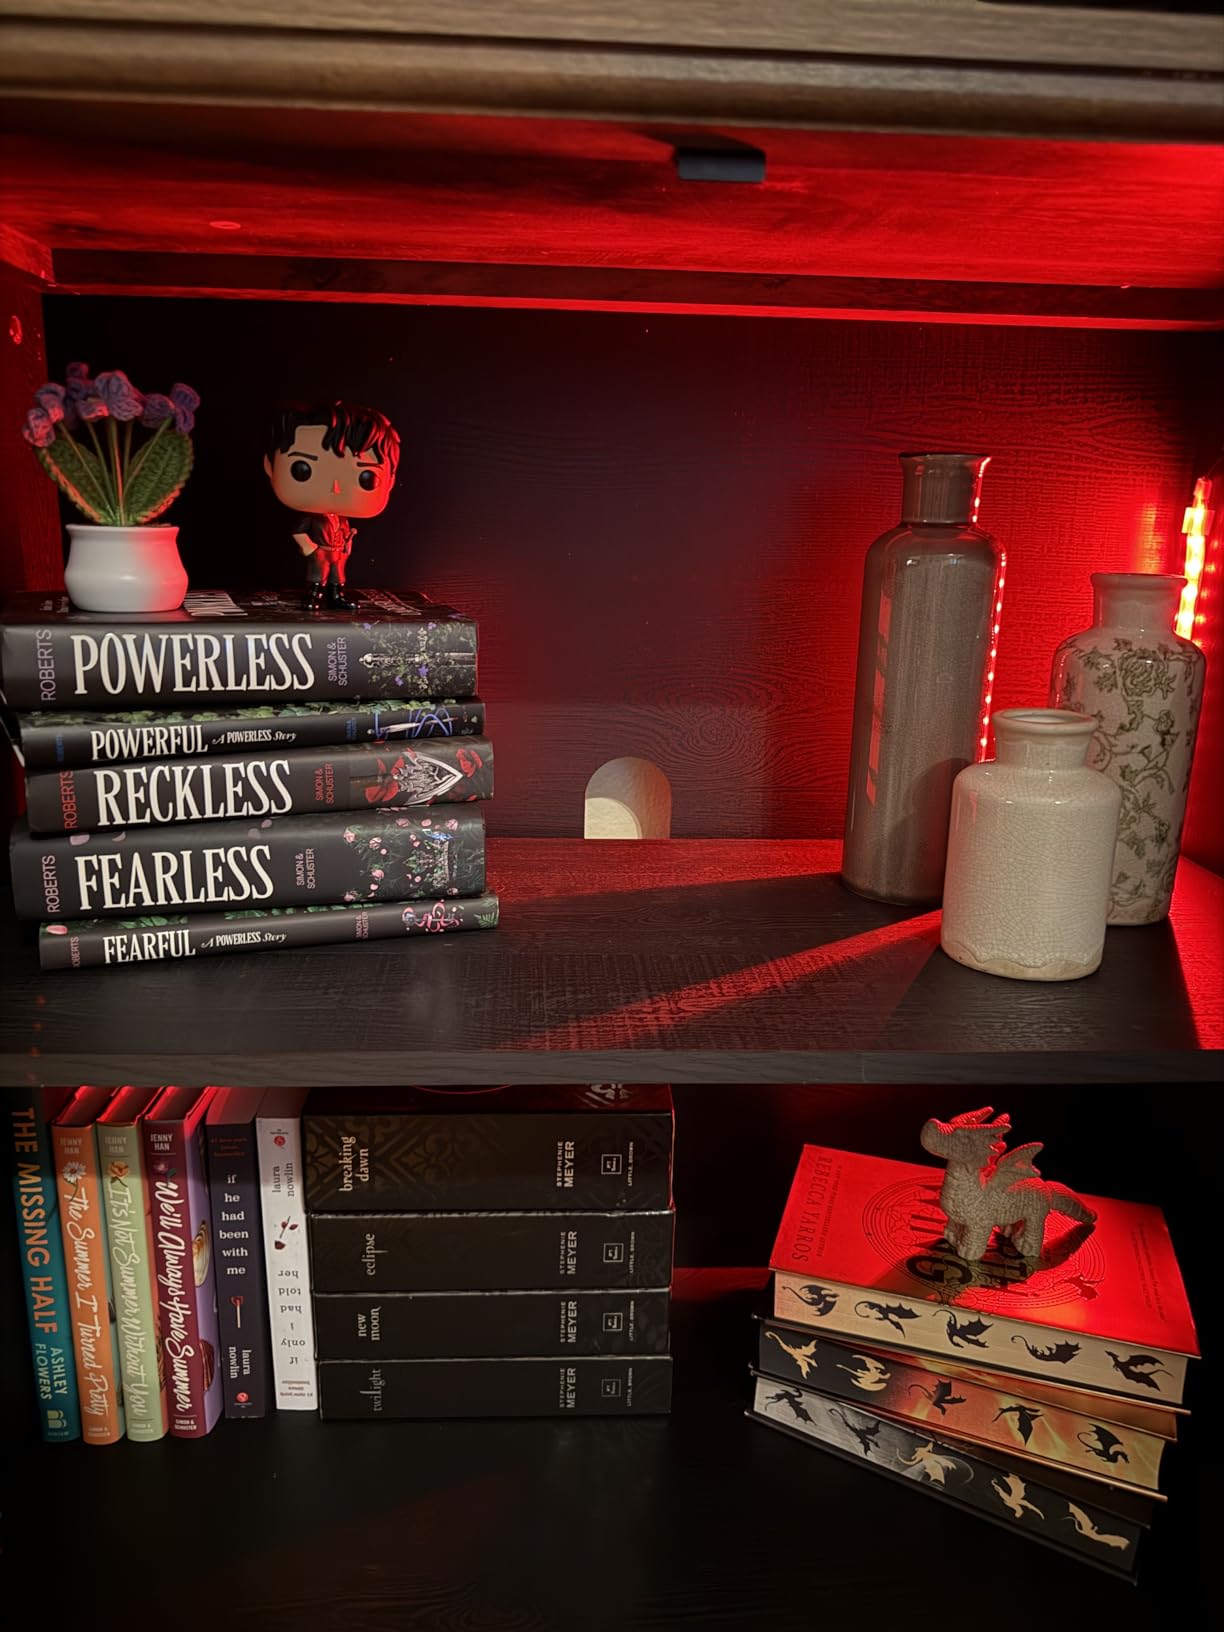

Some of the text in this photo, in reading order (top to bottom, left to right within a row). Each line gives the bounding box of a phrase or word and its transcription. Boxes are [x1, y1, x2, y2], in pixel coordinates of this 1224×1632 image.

[35, 628, 56, 701] ROBERTS
[70, 632, 315, 695] POWERLESS
[328, 652, 338, 682] SIMON
[337, 637, 348, 686] SCHUSTER
[90, 725, 208, 760] POWERFUL
[212, 729, 297, 744] A POWERLESS Story
[58, 770, 78, 829] ROBERTS
[93, 760, 293, 827] RECKLESS
[314, 775, 324, 801] SIMON
[325, 763, 335, 804] SCHUSTER
[42, 855, 61, 913] ROBERTS
[74, 845, 274, 911] FEARLESS
[296, 859, 305, 886] SIMON
[305, 848, 316, 889] SCHUSTER
[102, 929, 196, 964] FEARFUL
[201, 931, 287, 949] A POWERLESS Story
[150, 1133, 173, 1142] JENNY
[154, 1142, 170, 1151] HAN
[227, 1175, 237, 1184] if
[272, 1166, 281, 1193] laura
[284, 1162, 294, 1197] nowlin
[339, 1136, 357, 1192] breaking
[355, 1148, 369, 1182] dawn
[564, 1141, 575, 1188] MEYER
[806, 1156, 832, 1206] REBECCA
[224, 1193, 240, 1203] he
[11, 1107, 58, 1334] THE MISSING HALF
[222, 1211, 245, 1221] had
[219, 1230, 249, 1239] been
[222, 1247, 248, 1257] with
[792, 1210, 820, 1262] YARROS
[226, 1266, 246, 1275] me
[361, 1233, 388, 1276] eclipse
[567, 1231, 577, 1275] MEYER
[112, 1246, 141, 1316] Summer
[278, 1270, 299, 1279] her
[278, 1287, 301, 1296] told
[64, 1187, 109, 1416] The Summer I Turned Pretty
[155, 1181, 195, 1412] We'll Always Have Summer
[280, 1305, 302, 1313] had
[357, 1313, 367, 1337] new
[370, 1306, 382, 1341] moon
[567, 1301, 577, 1343] MEYER
[120, 1317, 147, 1384] Without
[281, 1338, 306, 1347] only
[35, 1343, 52, 1400] FLOWERS
[50, 1347, 68, 1394] ASHLEY
[228, 1346, 240, 1378] nowlin
[242, 1349, 252, 1375] laura
[122, 1383, 150, 1417] You
[360, 1369, 386, 1412] twilight
[566, 1368, 576, 1408] MEYER
